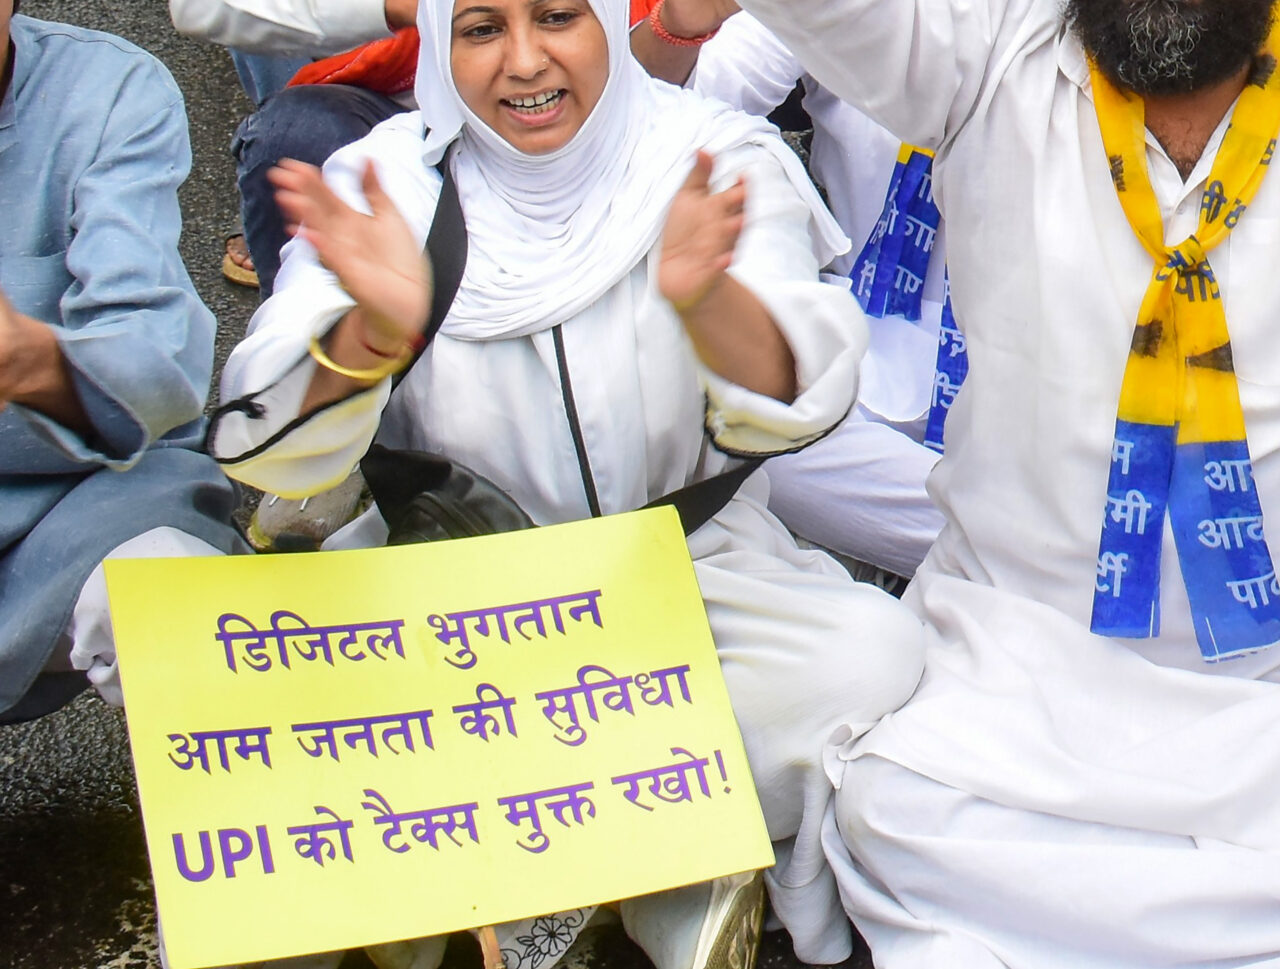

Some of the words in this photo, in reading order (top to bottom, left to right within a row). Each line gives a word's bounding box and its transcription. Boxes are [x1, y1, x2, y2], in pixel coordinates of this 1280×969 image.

[215, 611, 406, 674] डिजिटल
[427, 589, 604, 670] भुगतान
[168, 727, 272, 775] आम
[291, 710, 435, 763] जनता
[452, 683, 517, 742] की
[536, 664, 693, 748] सुविधा
[172, 825, 276, 883] UPI
[287, 805, 355, 866] को
[361, 788, 479, 853] टैक्स
[498, 781, 597, 854] मुक्त
[610, 749, 733, 813] रखो!
